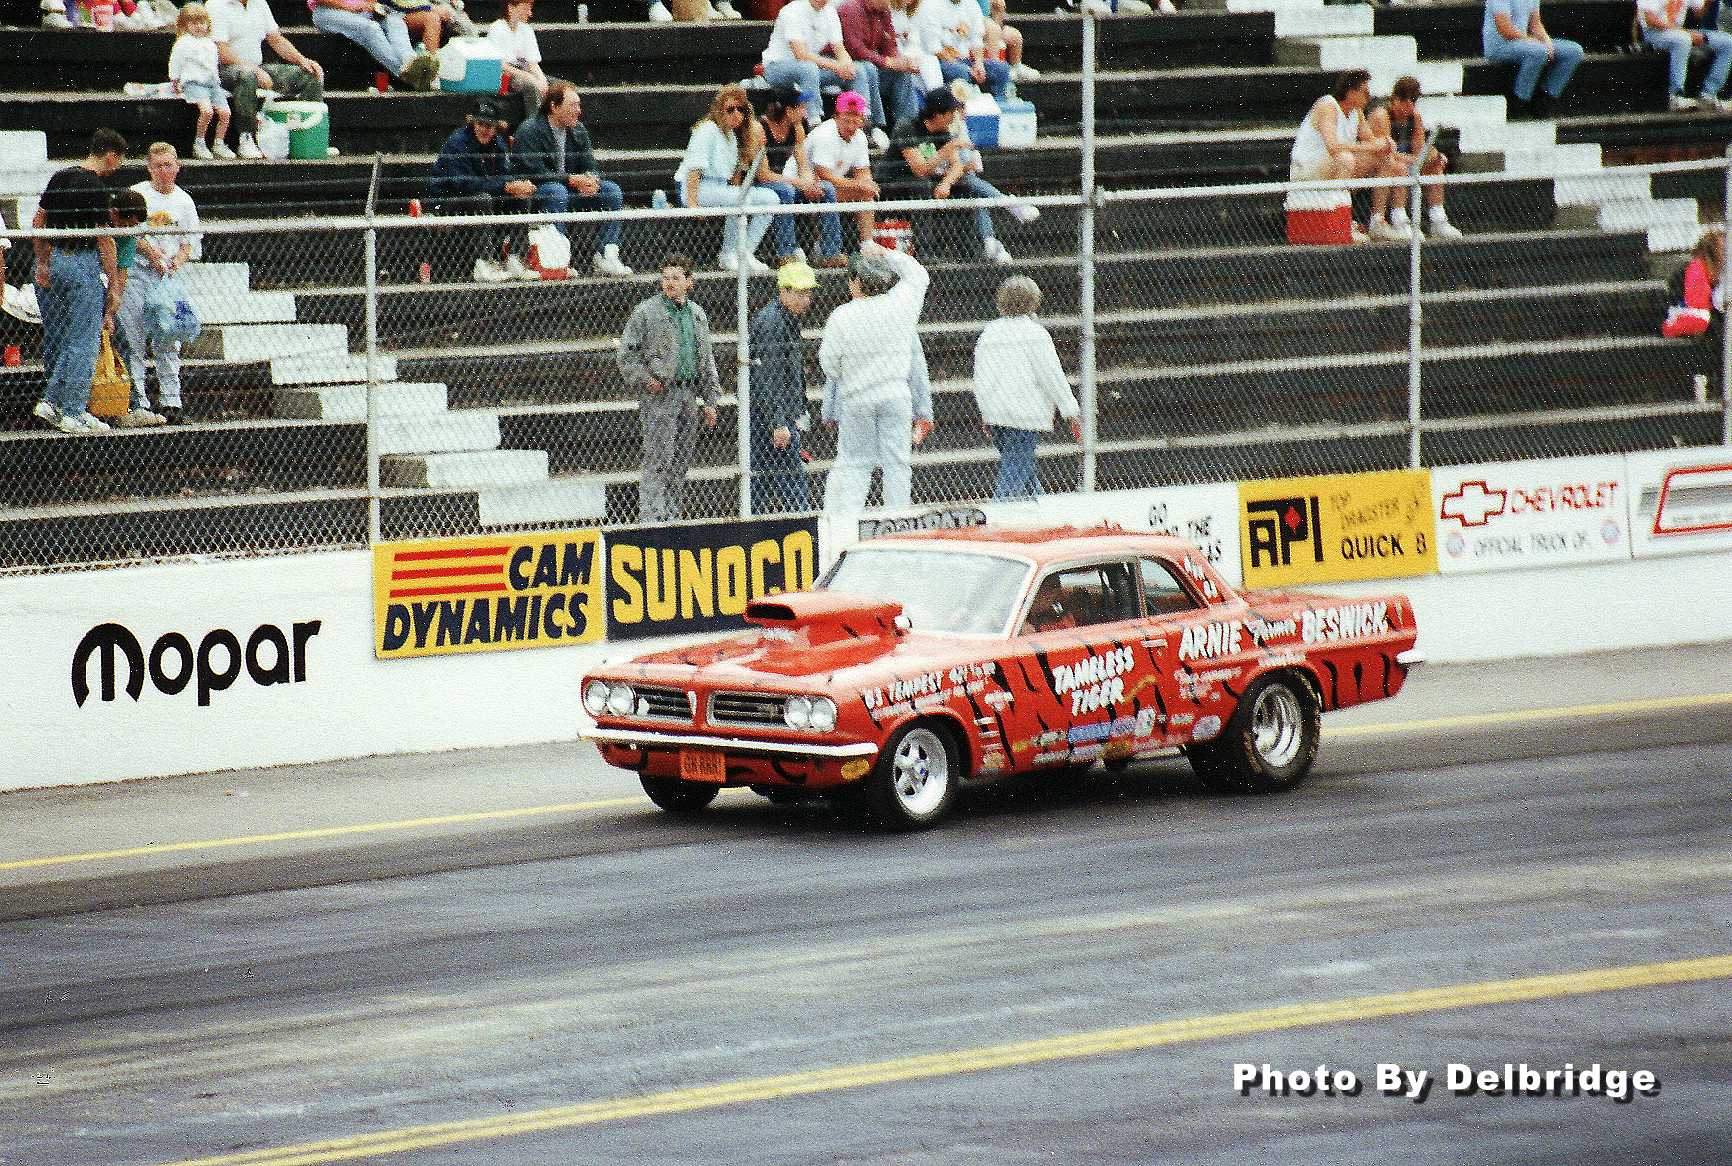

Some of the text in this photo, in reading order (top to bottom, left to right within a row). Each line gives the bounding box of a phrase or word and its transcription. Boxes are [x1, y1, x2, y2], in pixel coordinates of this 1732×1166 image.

[1511, 481, 1619, 514] CHEVROLET
[1247, 496, 1324, 568] API
[1341, 533, 1404, 560] QUICK
[509, 542, 595, 591] CAM
[609, 529, 817, 626] SUNOCO
[382, 593, 590, 652] DYNAMICS
[1179, 619, 1243, 662] ARNIE
[1302, 602, 1389, 645] BESWICK
[71, 620, 322, 708] Mopar
[1052, 645, 1135, 695] TAMELESS
[1072, 676, 1125, 717] TIGER
